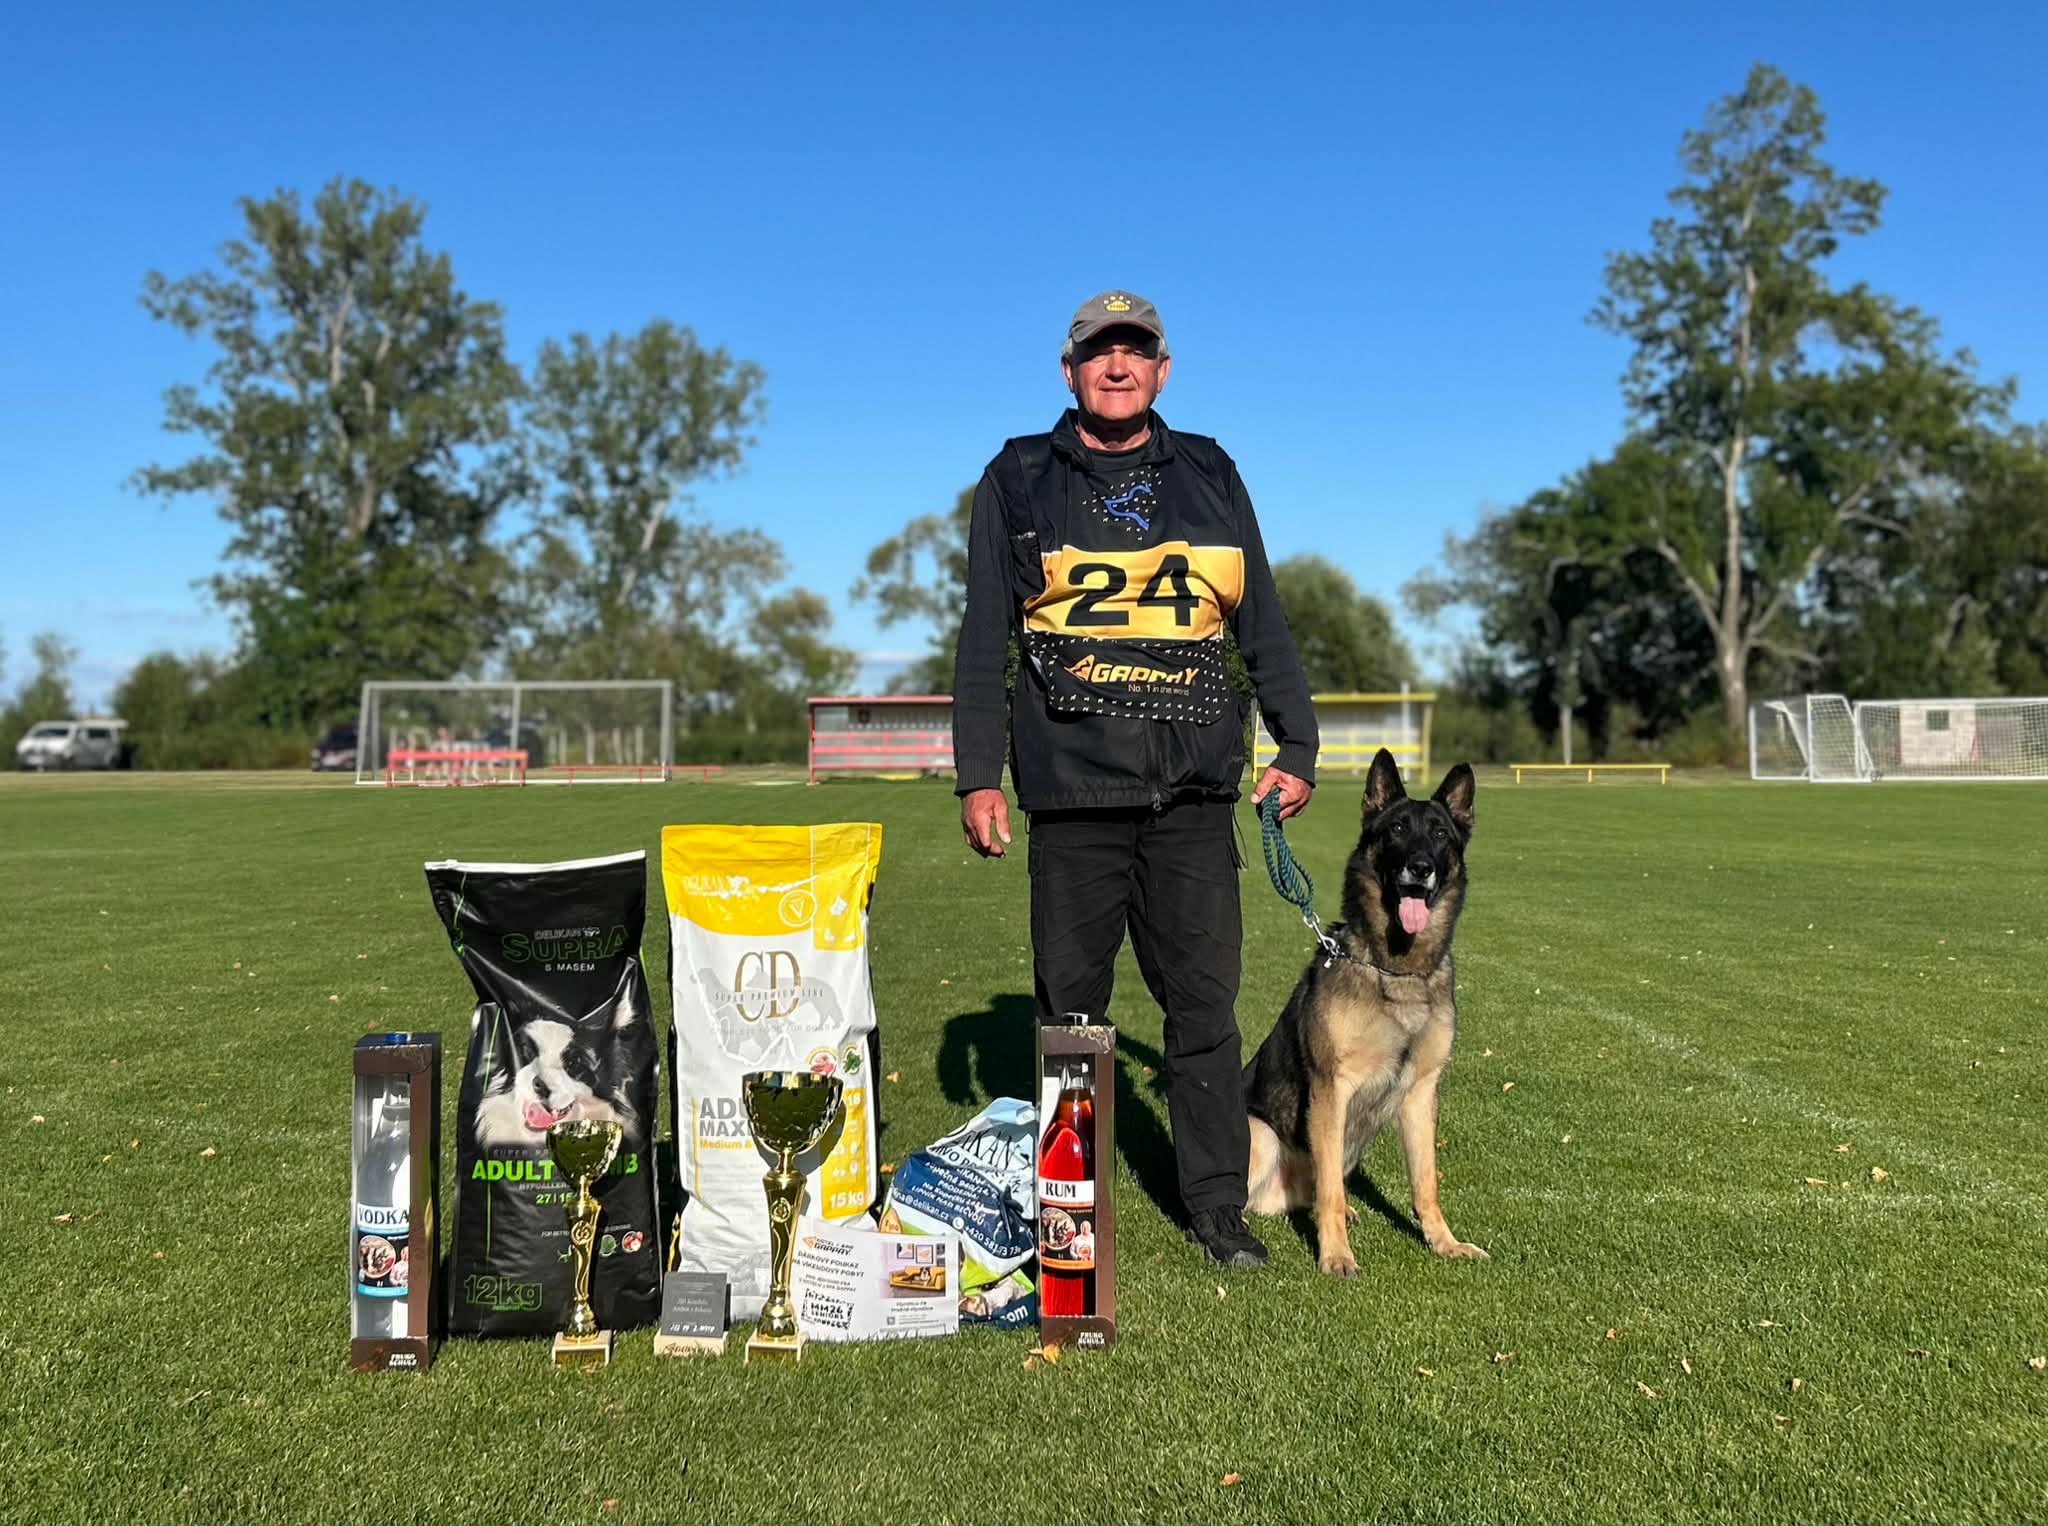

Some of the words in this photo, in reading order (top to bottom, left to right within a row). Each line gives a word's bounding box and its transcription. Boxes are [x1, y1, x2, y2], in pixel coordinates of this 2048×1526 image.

[1065, 554, 1199, 626] 24
[1128, 684, 1142, 692] No.
[502, 925, 629, 962] SUPRA
[557, 963, 595, 972] MASEM
[735, 951, 801, 1022] CD
[700, 1139, 742, 1150] Medium
[472, 1159, 555, 1182] ADULT
[1046, 1182, 1076, 1197] RUM
[536, 1193, 552, 1205] 27
[359, 1207, 409, 1225] VODKA
[965, 1225, 984, 1241] +420
[464, 1274, 543, 1312] 12kg
